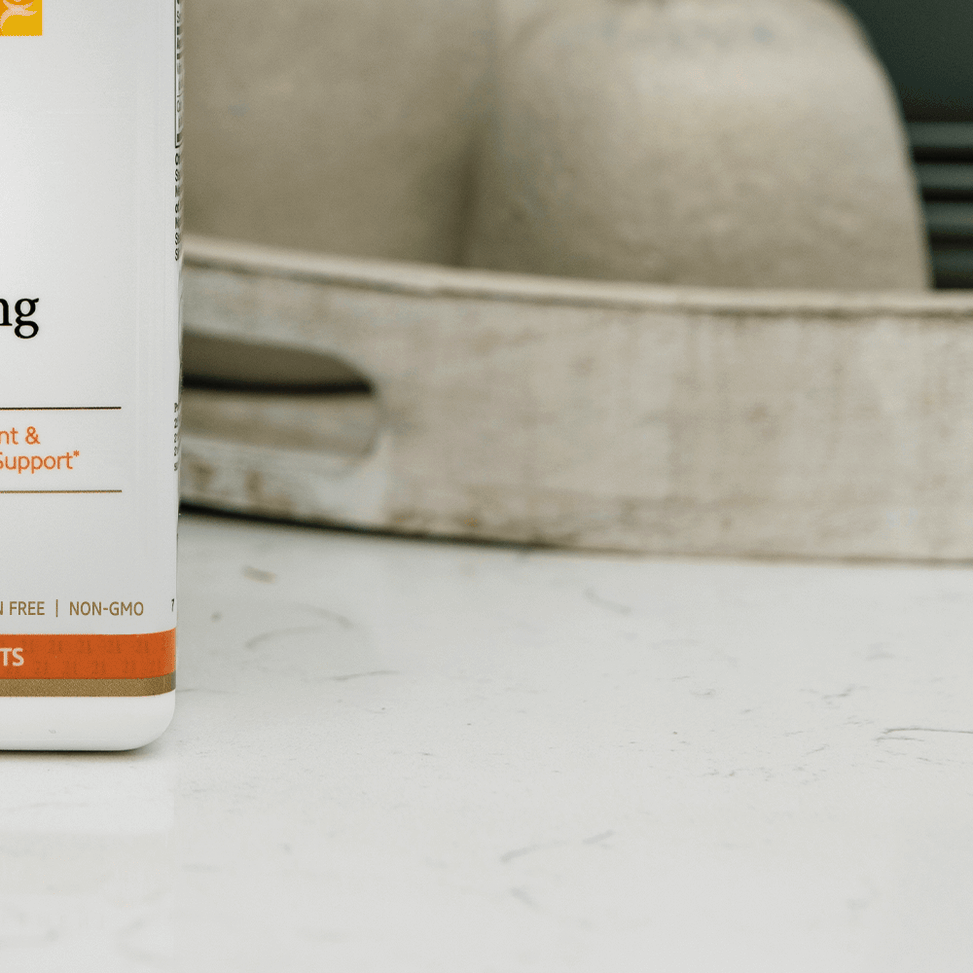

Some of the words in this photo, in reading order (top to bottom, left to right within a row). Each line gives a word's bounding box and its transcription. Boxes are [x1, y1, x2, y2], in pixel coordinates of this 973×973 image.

[25, 425, 41, 446] &
[9, 600, 46, 616] FREE
[69, 600, 145, 617] NON-GMO
